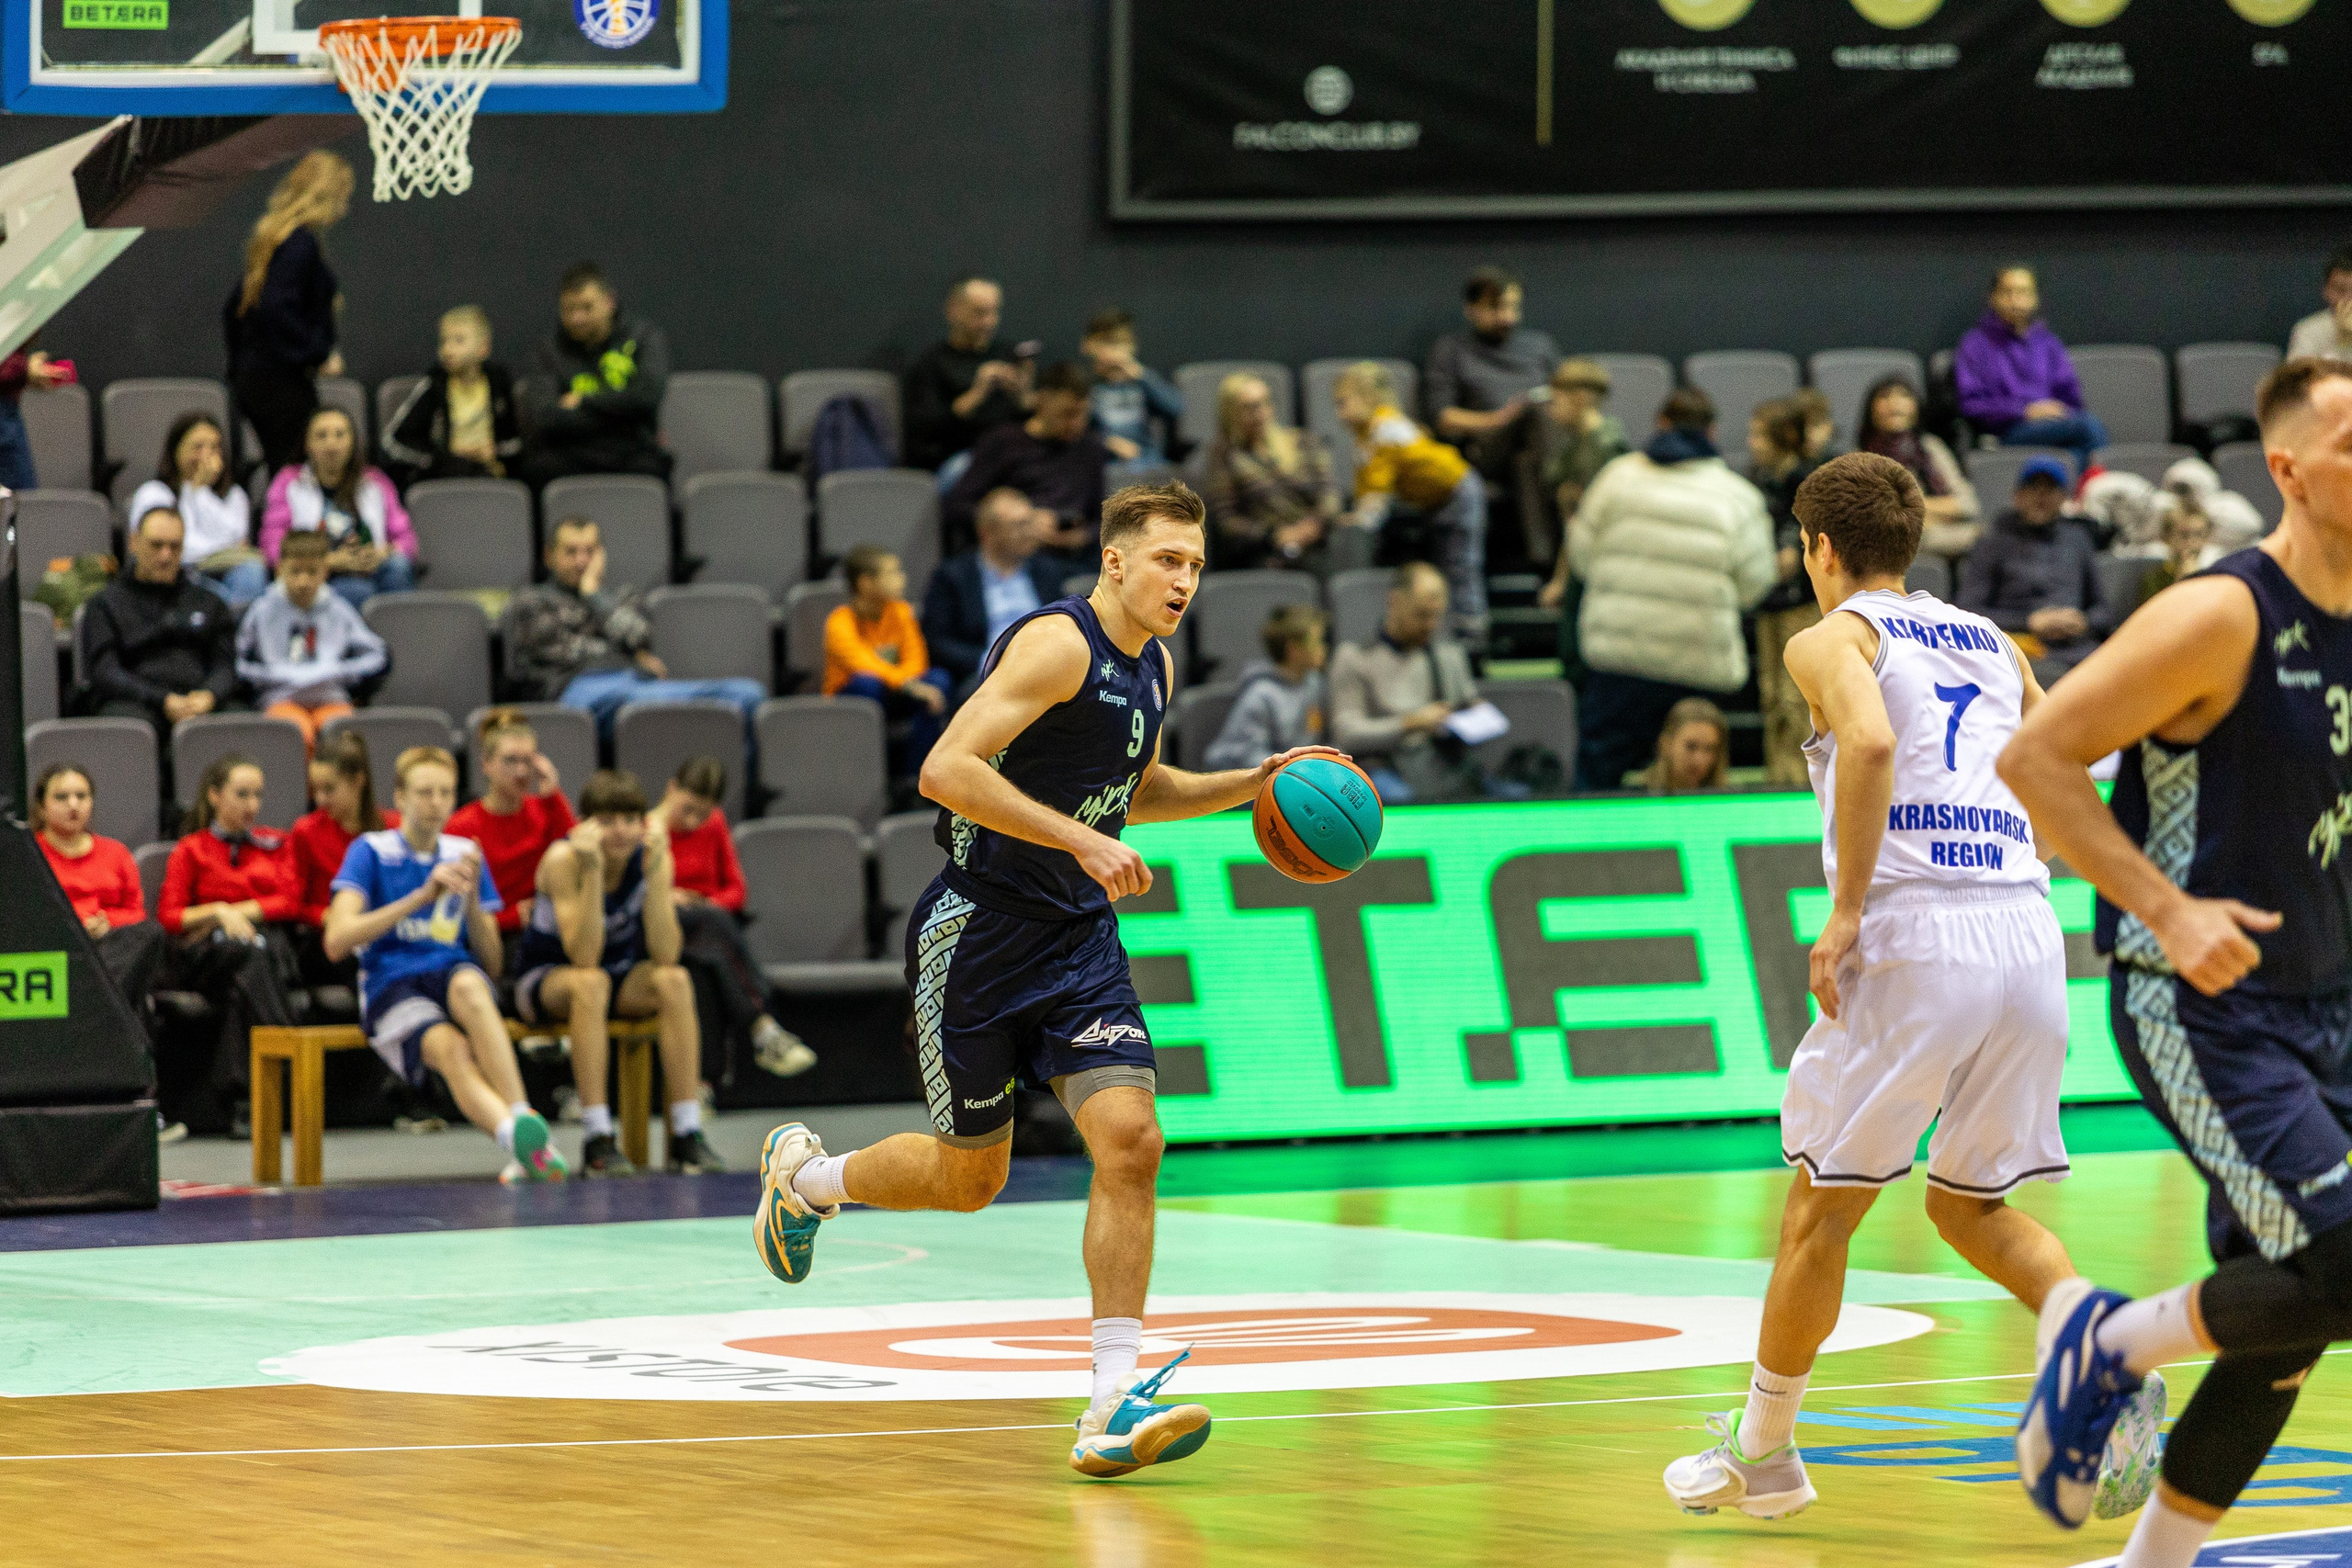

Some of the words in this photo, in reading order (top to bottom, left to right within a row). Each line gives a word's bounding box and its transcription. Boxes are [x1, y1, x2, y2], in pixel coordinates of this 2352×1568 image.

[1099, 690, 1127, 707] Kempa
[1126, 709, 1145, 758] 9
[1934, 682, 1982, 772] 7
[2325, 684, 2352, 756] 3
[1889, 803, 2029, 844] KRASNOYARSK
[1931, 840, 2003, 871] REGION
[963, 1090, 1004, 1109] Kempa
